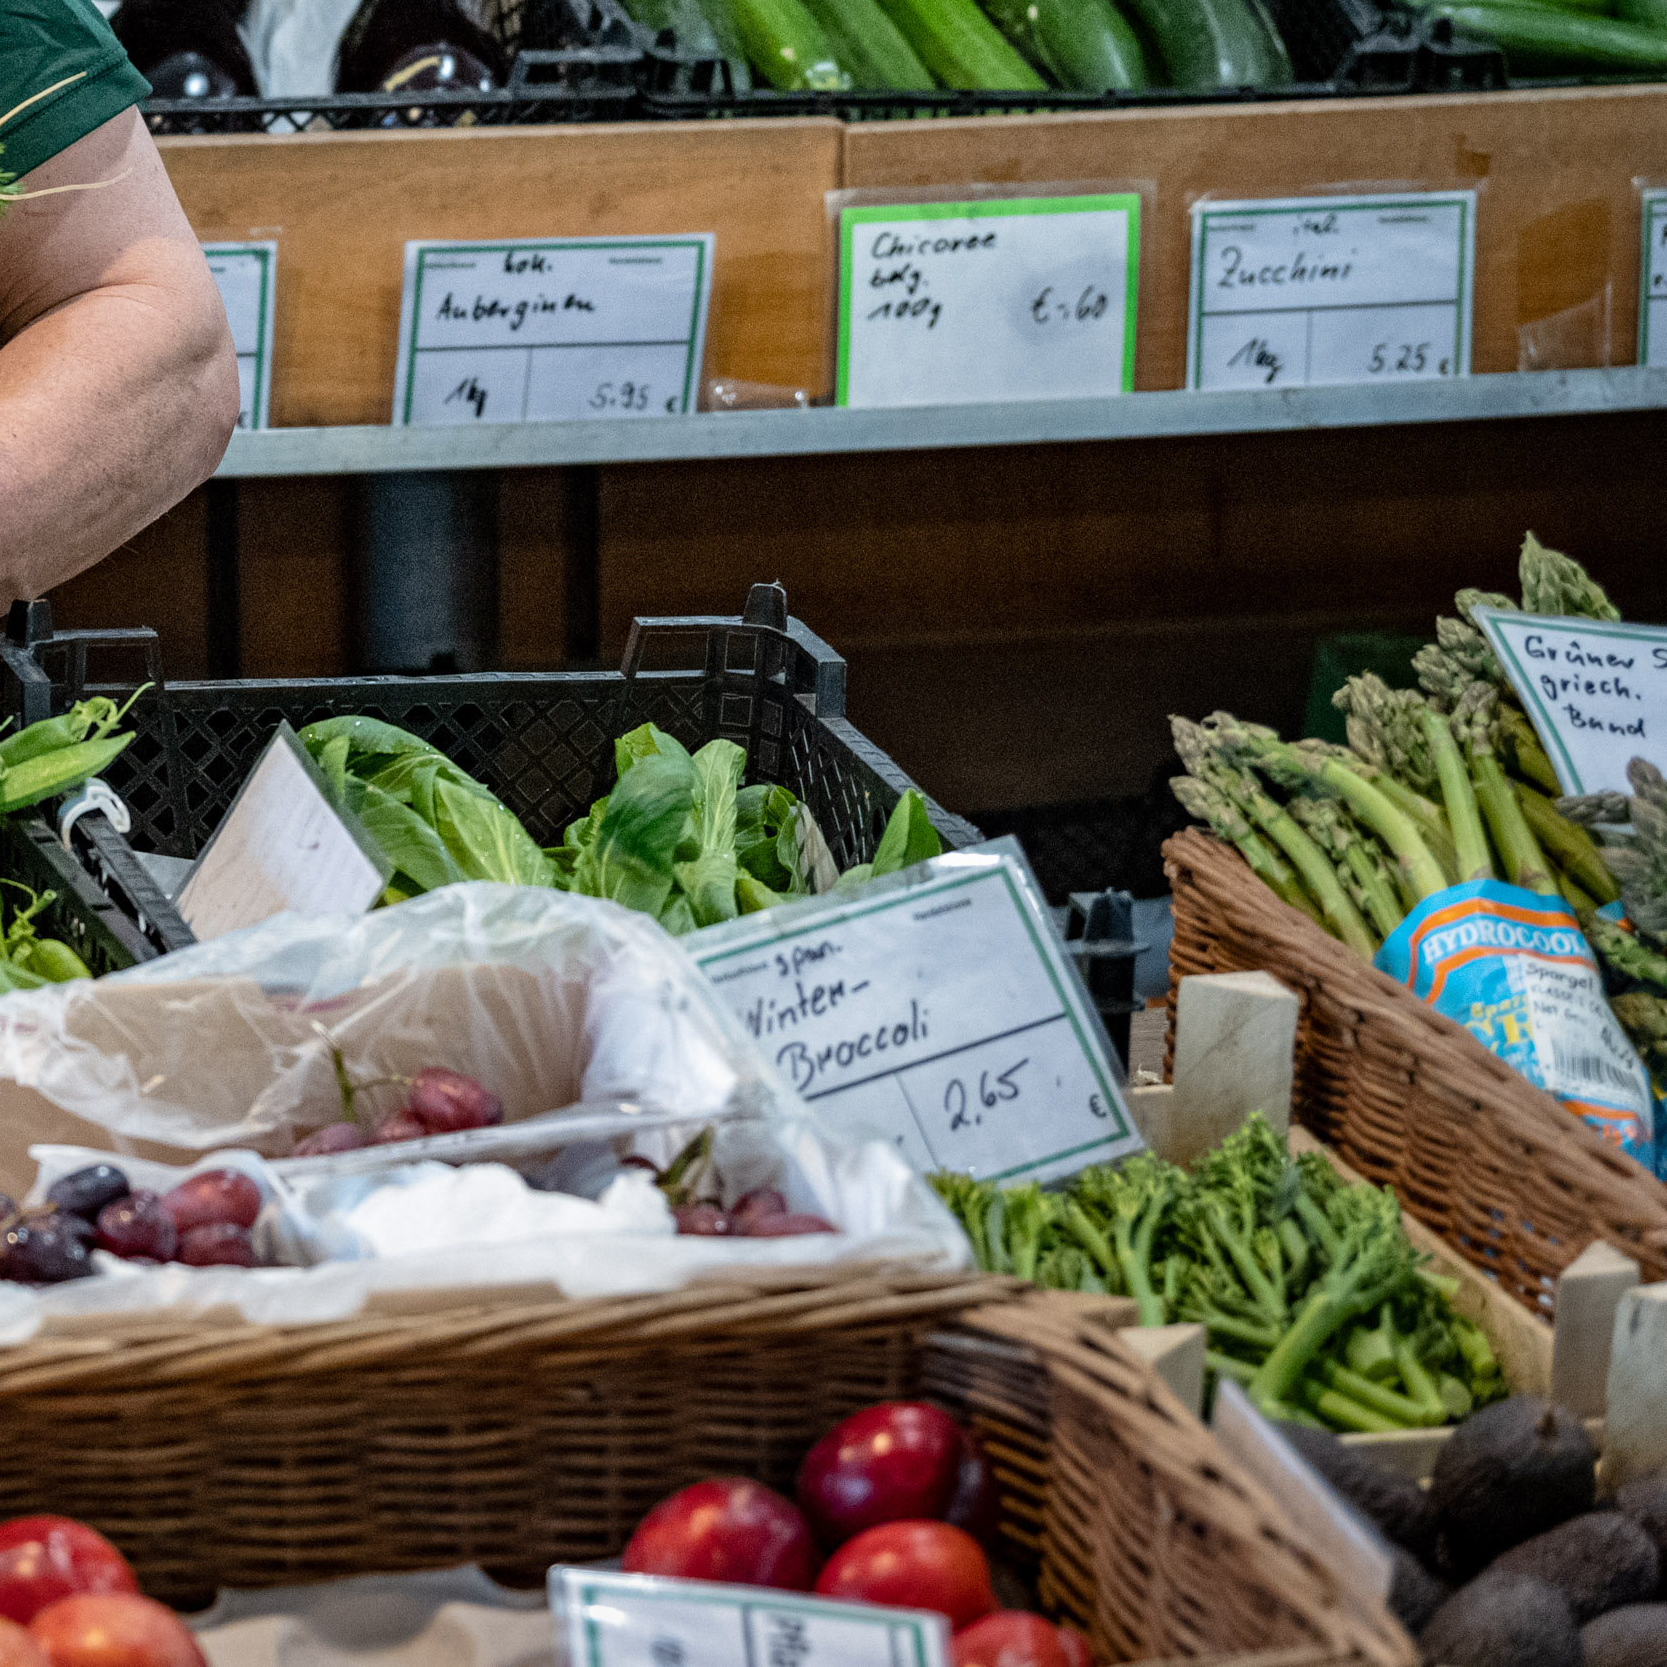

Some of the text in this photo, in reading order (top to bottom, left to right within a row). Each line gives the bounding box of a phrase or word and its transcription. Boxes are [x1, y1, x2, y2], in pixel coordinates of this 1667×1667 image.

[871, 230, 998, 259] Chicoree
[1217, 245, 1359, 289] Zucchini
[436, 292, 596, 331] Auberginen
[866, 296, 942, 330] 100g
[1525, 635, 1667, 669] Grüner S
[1540, 674, 1641, 701] griech.
[1562, 703, 1646, 738] Bund
[1526, 962, 1593, 991] Spargel
[775, 999, 929, 1092] Broccoli
[1088, 1093, 1107, 1119] €
